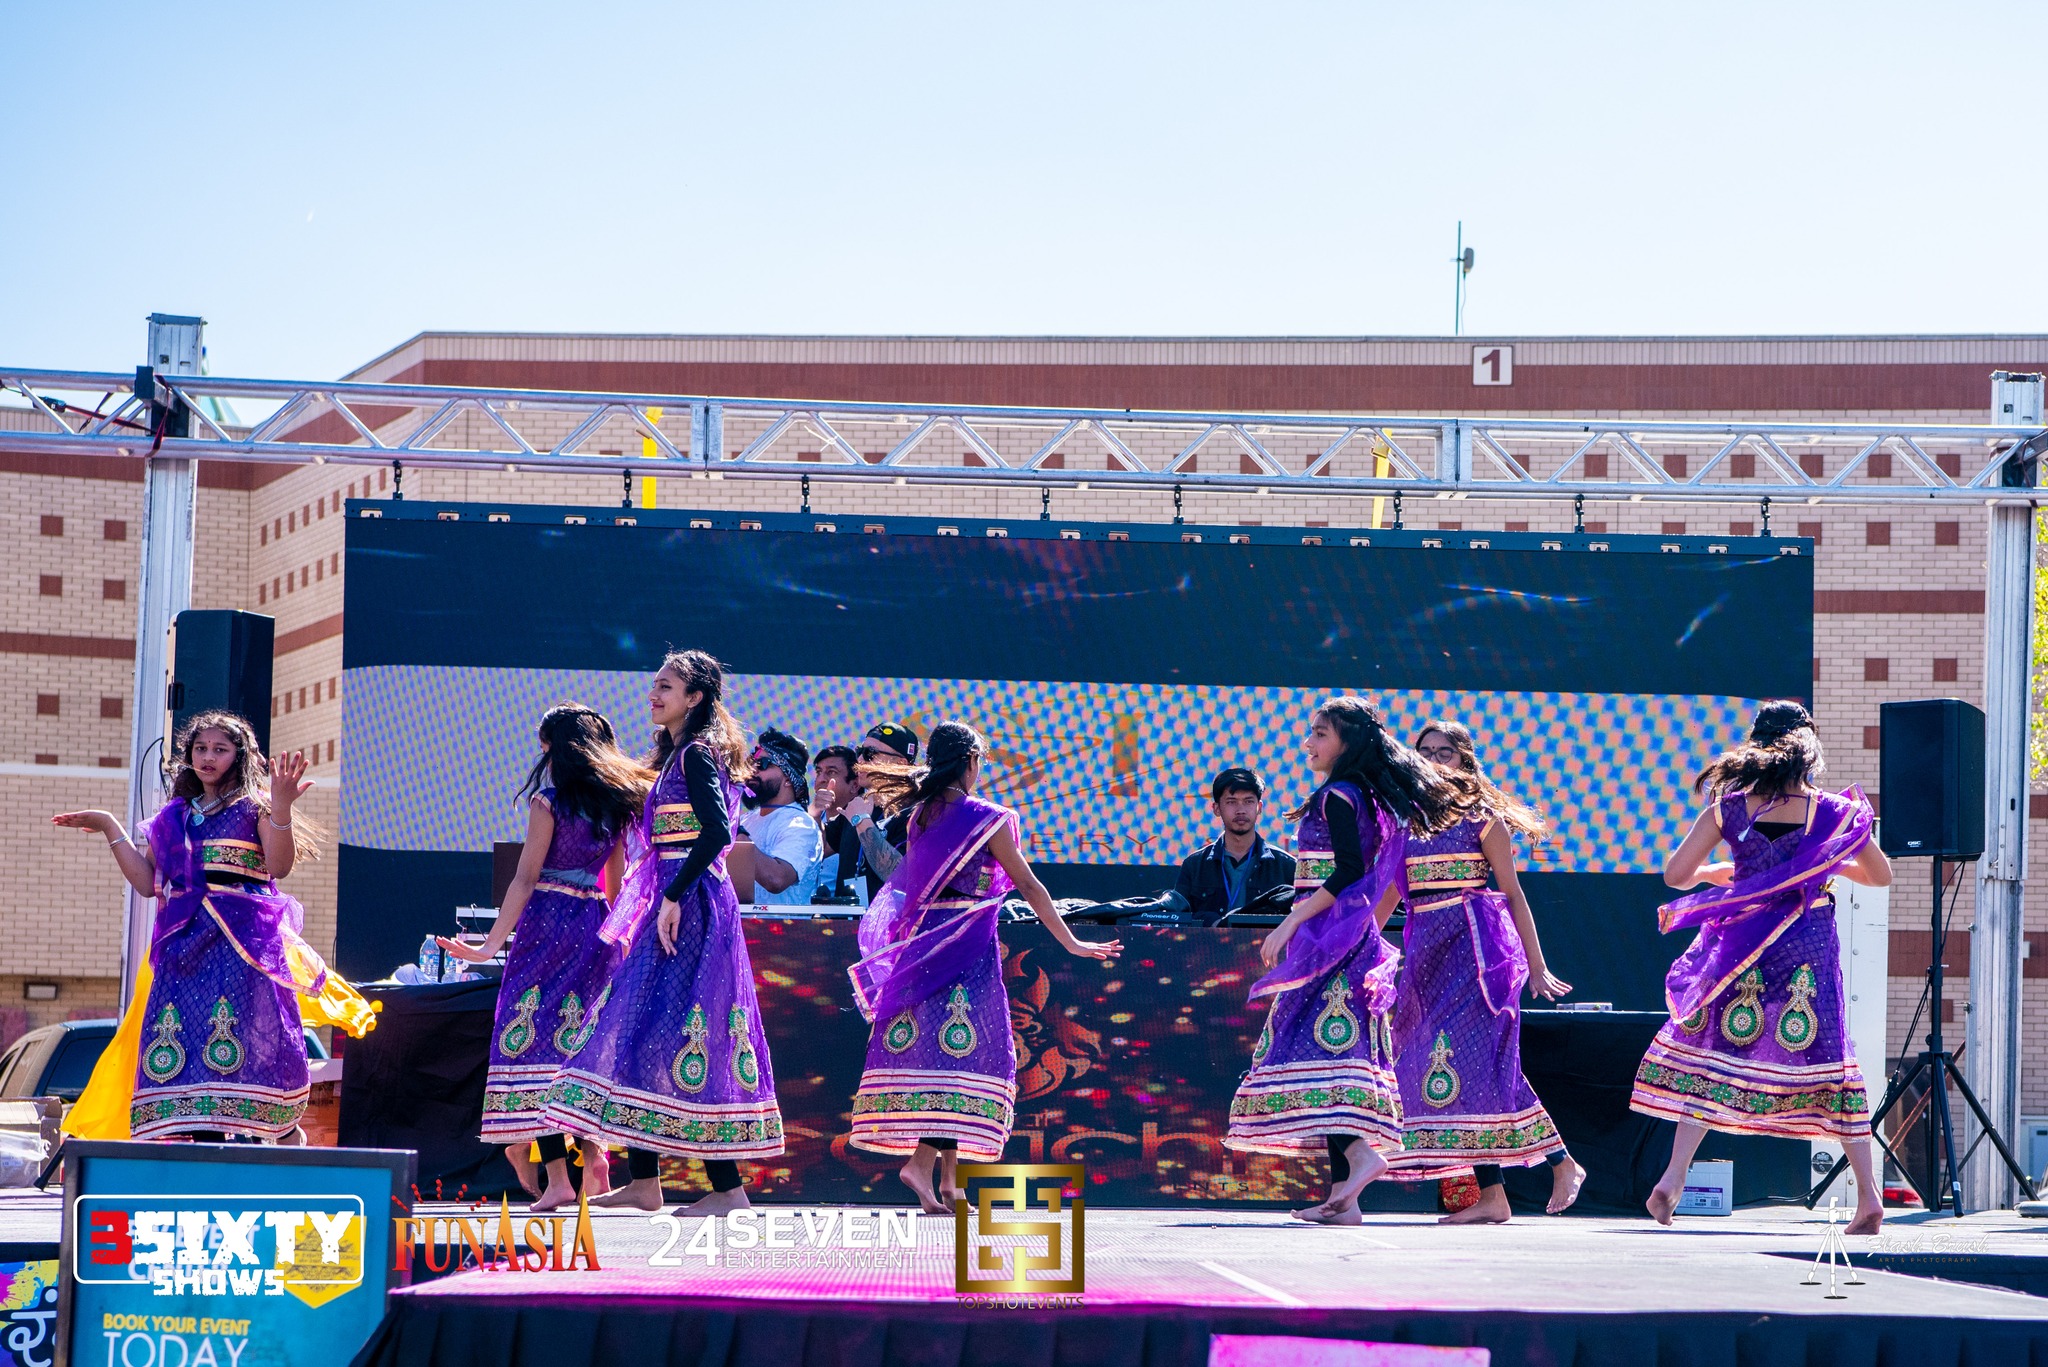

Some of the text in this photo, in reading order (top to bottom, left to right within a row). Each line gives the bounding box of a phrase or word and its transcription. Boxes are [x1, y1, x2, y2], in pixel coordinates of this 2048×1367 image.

[1482, 349, 1500, 382] 1
[103, 1313, 251, 1336] BOOK YOUR EVENT
[103, 1331, 249, 1367] TODAY
